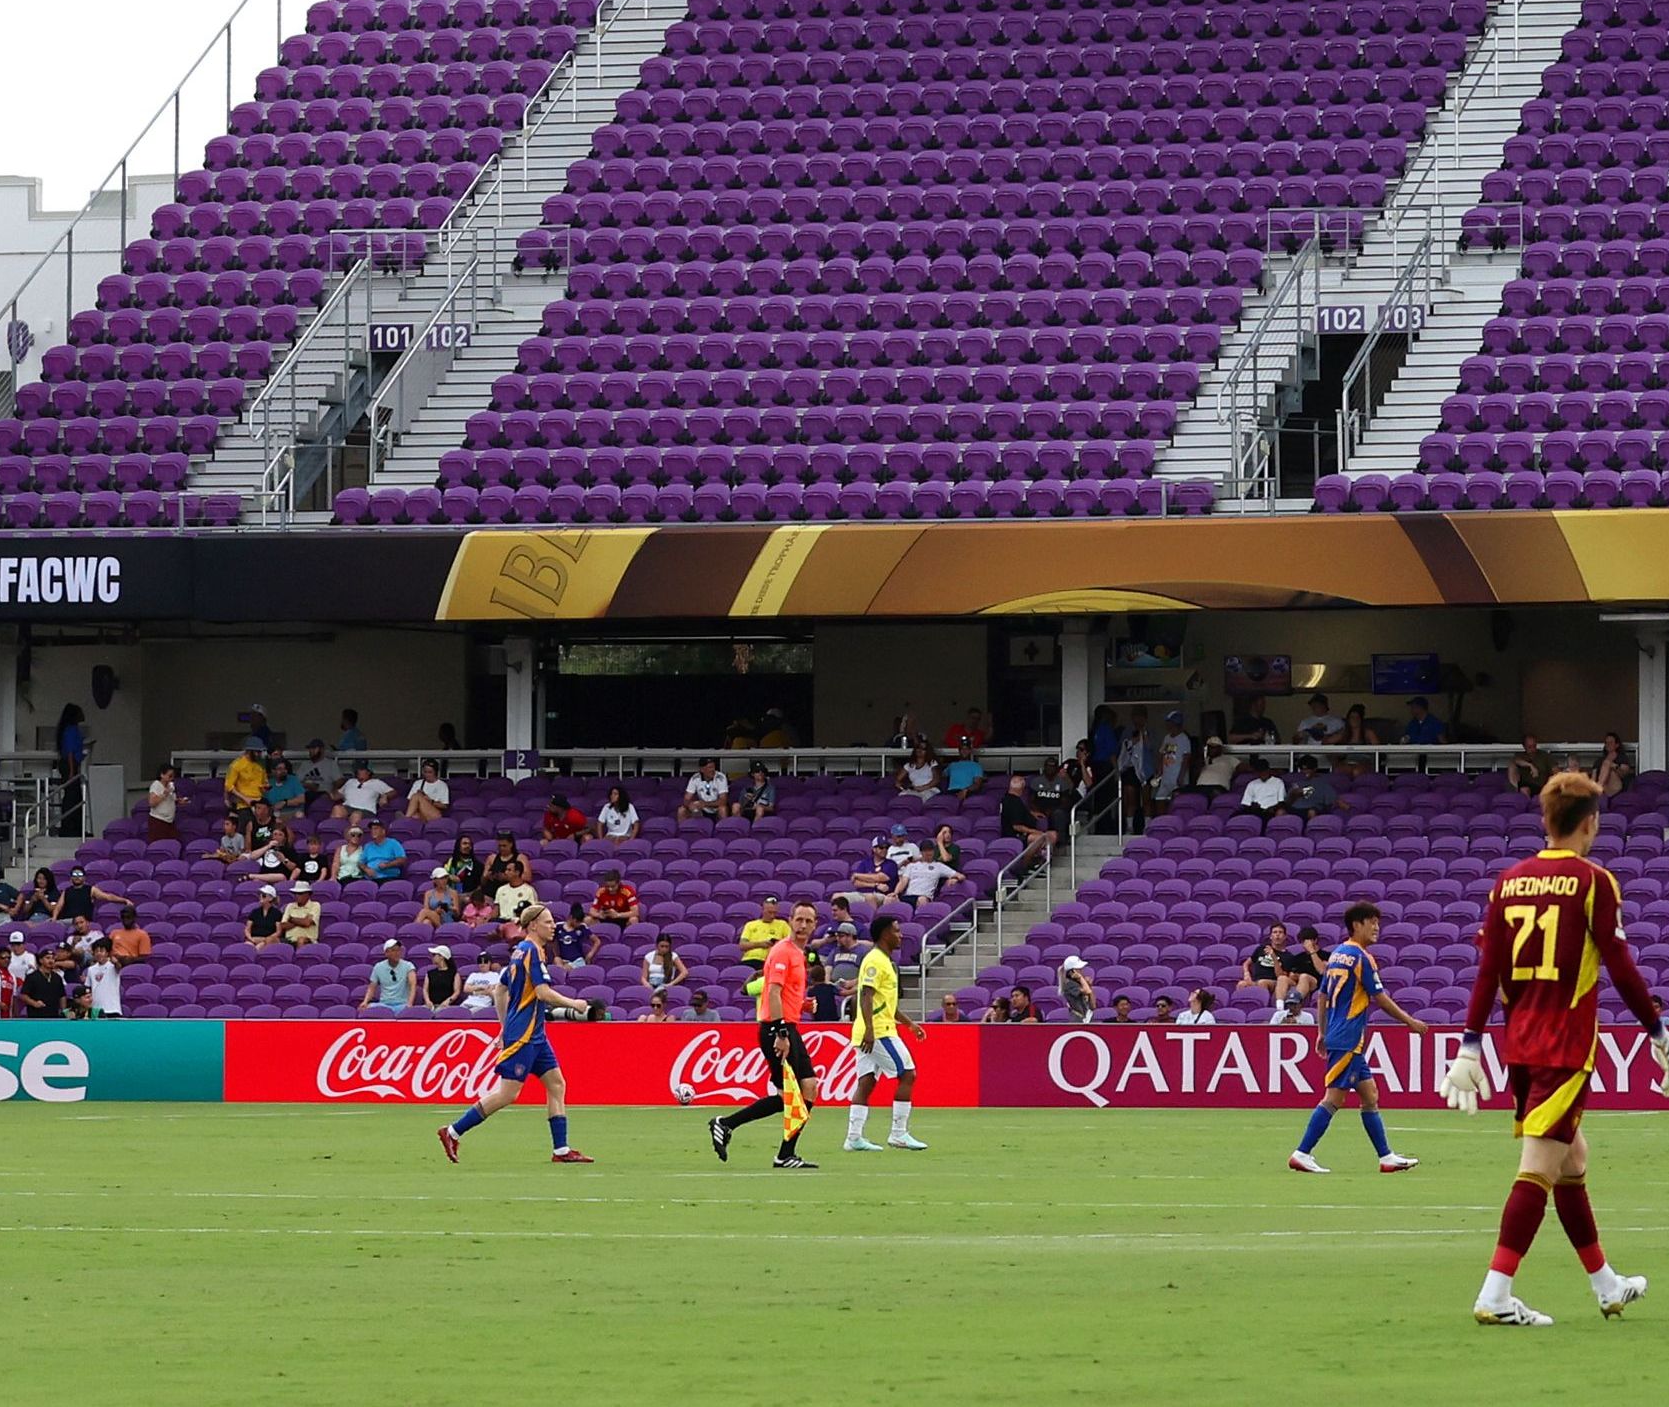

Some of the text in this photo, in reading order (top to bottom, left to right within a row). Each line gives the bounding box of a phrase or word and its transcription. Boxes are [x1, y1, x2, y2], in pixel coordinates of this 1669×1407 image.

[1319, 307, 1362, 331] 102
[373, 326, 410, 348] 101
[428, 325, 468, 348] 102
[517, 752, 526, 767] 2
[1500, 876, 1579, 899] HYEONWOO
[1504, 904, 1560, 981] 21
[1048, 1030, 1319, 1108] QATAR
